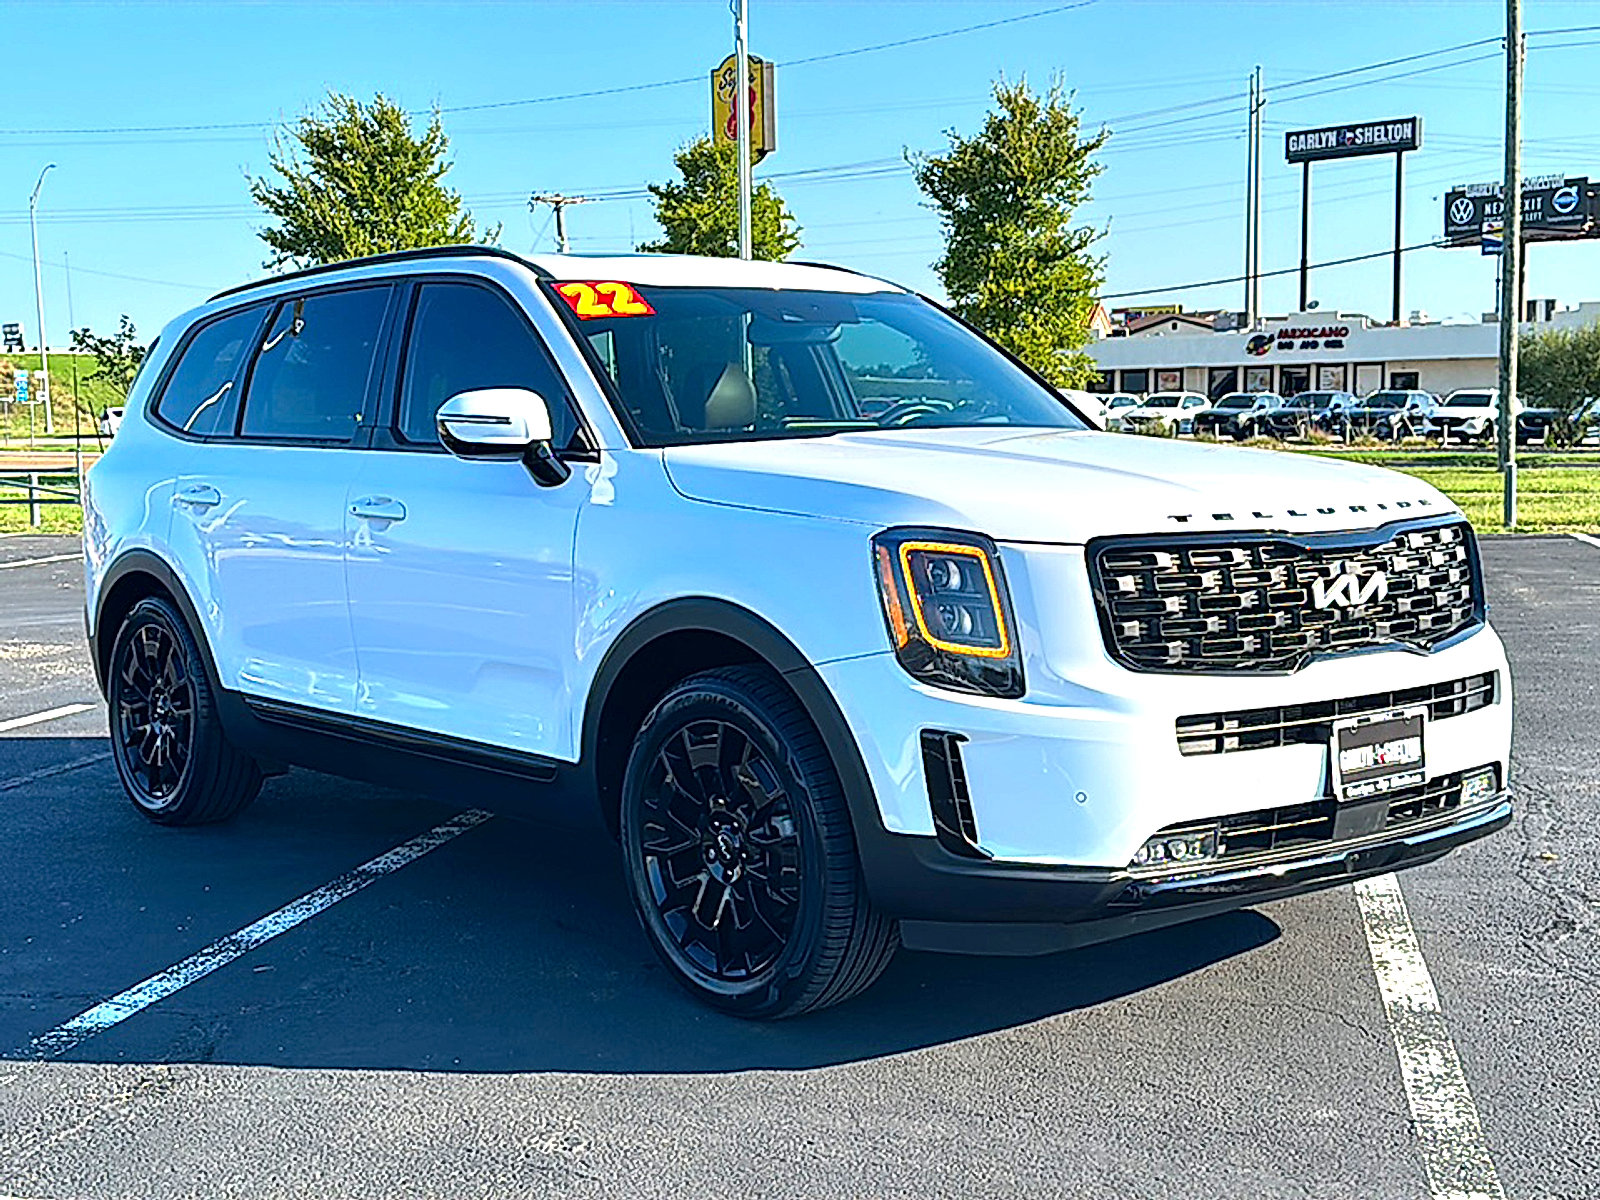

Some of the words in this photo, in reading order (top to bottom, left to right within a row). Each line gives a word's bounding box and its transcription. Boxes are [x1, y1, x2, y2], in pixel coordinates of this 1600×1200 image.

[1289, 130, 1337, 152] GARLYN
[1355, 122, 1412, 145] SHELTON
[560, 282, 648, 316] 22
[1277, 326, 1350, 340] MEXICANO
[1167, 499, 1433, 522] TELLURIDE
[1311, 570, 1389, 610] KIA
